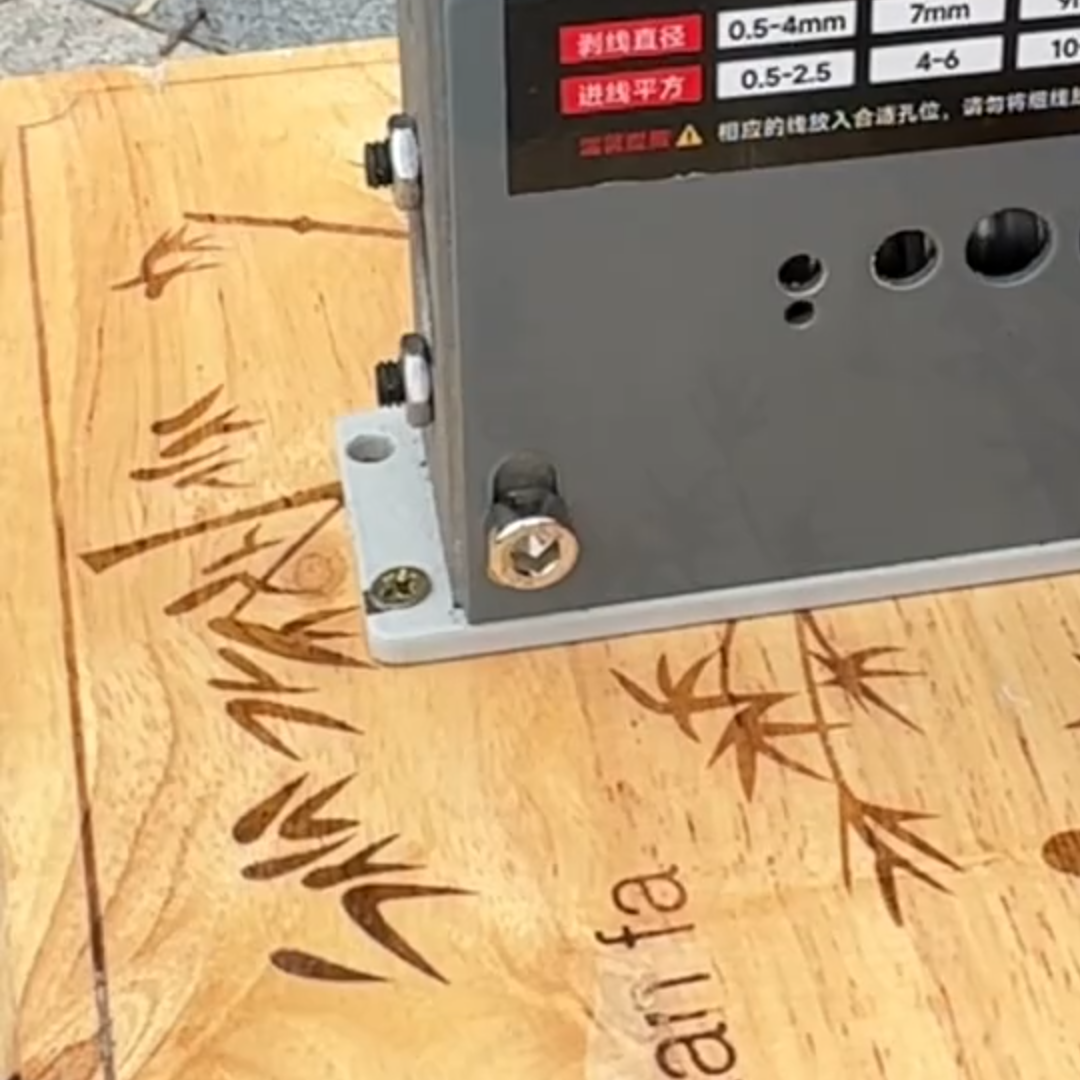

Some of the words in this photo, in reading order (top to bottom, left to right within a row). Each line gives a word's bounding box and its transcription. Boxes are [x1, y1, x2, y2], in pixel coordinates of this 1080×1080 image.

[577, 24, 686, 58] 剥线直径
[728, 14, 846, 40] 0.5-4mm
[910, 3, 970, 24] 7mm
[578, 75, 686, 107] 进线平方
[741, 62, 831, 89] 0.5-2.5
[916, 50, 960, 71] 4-6
[594, 864, 696, 949] fa
